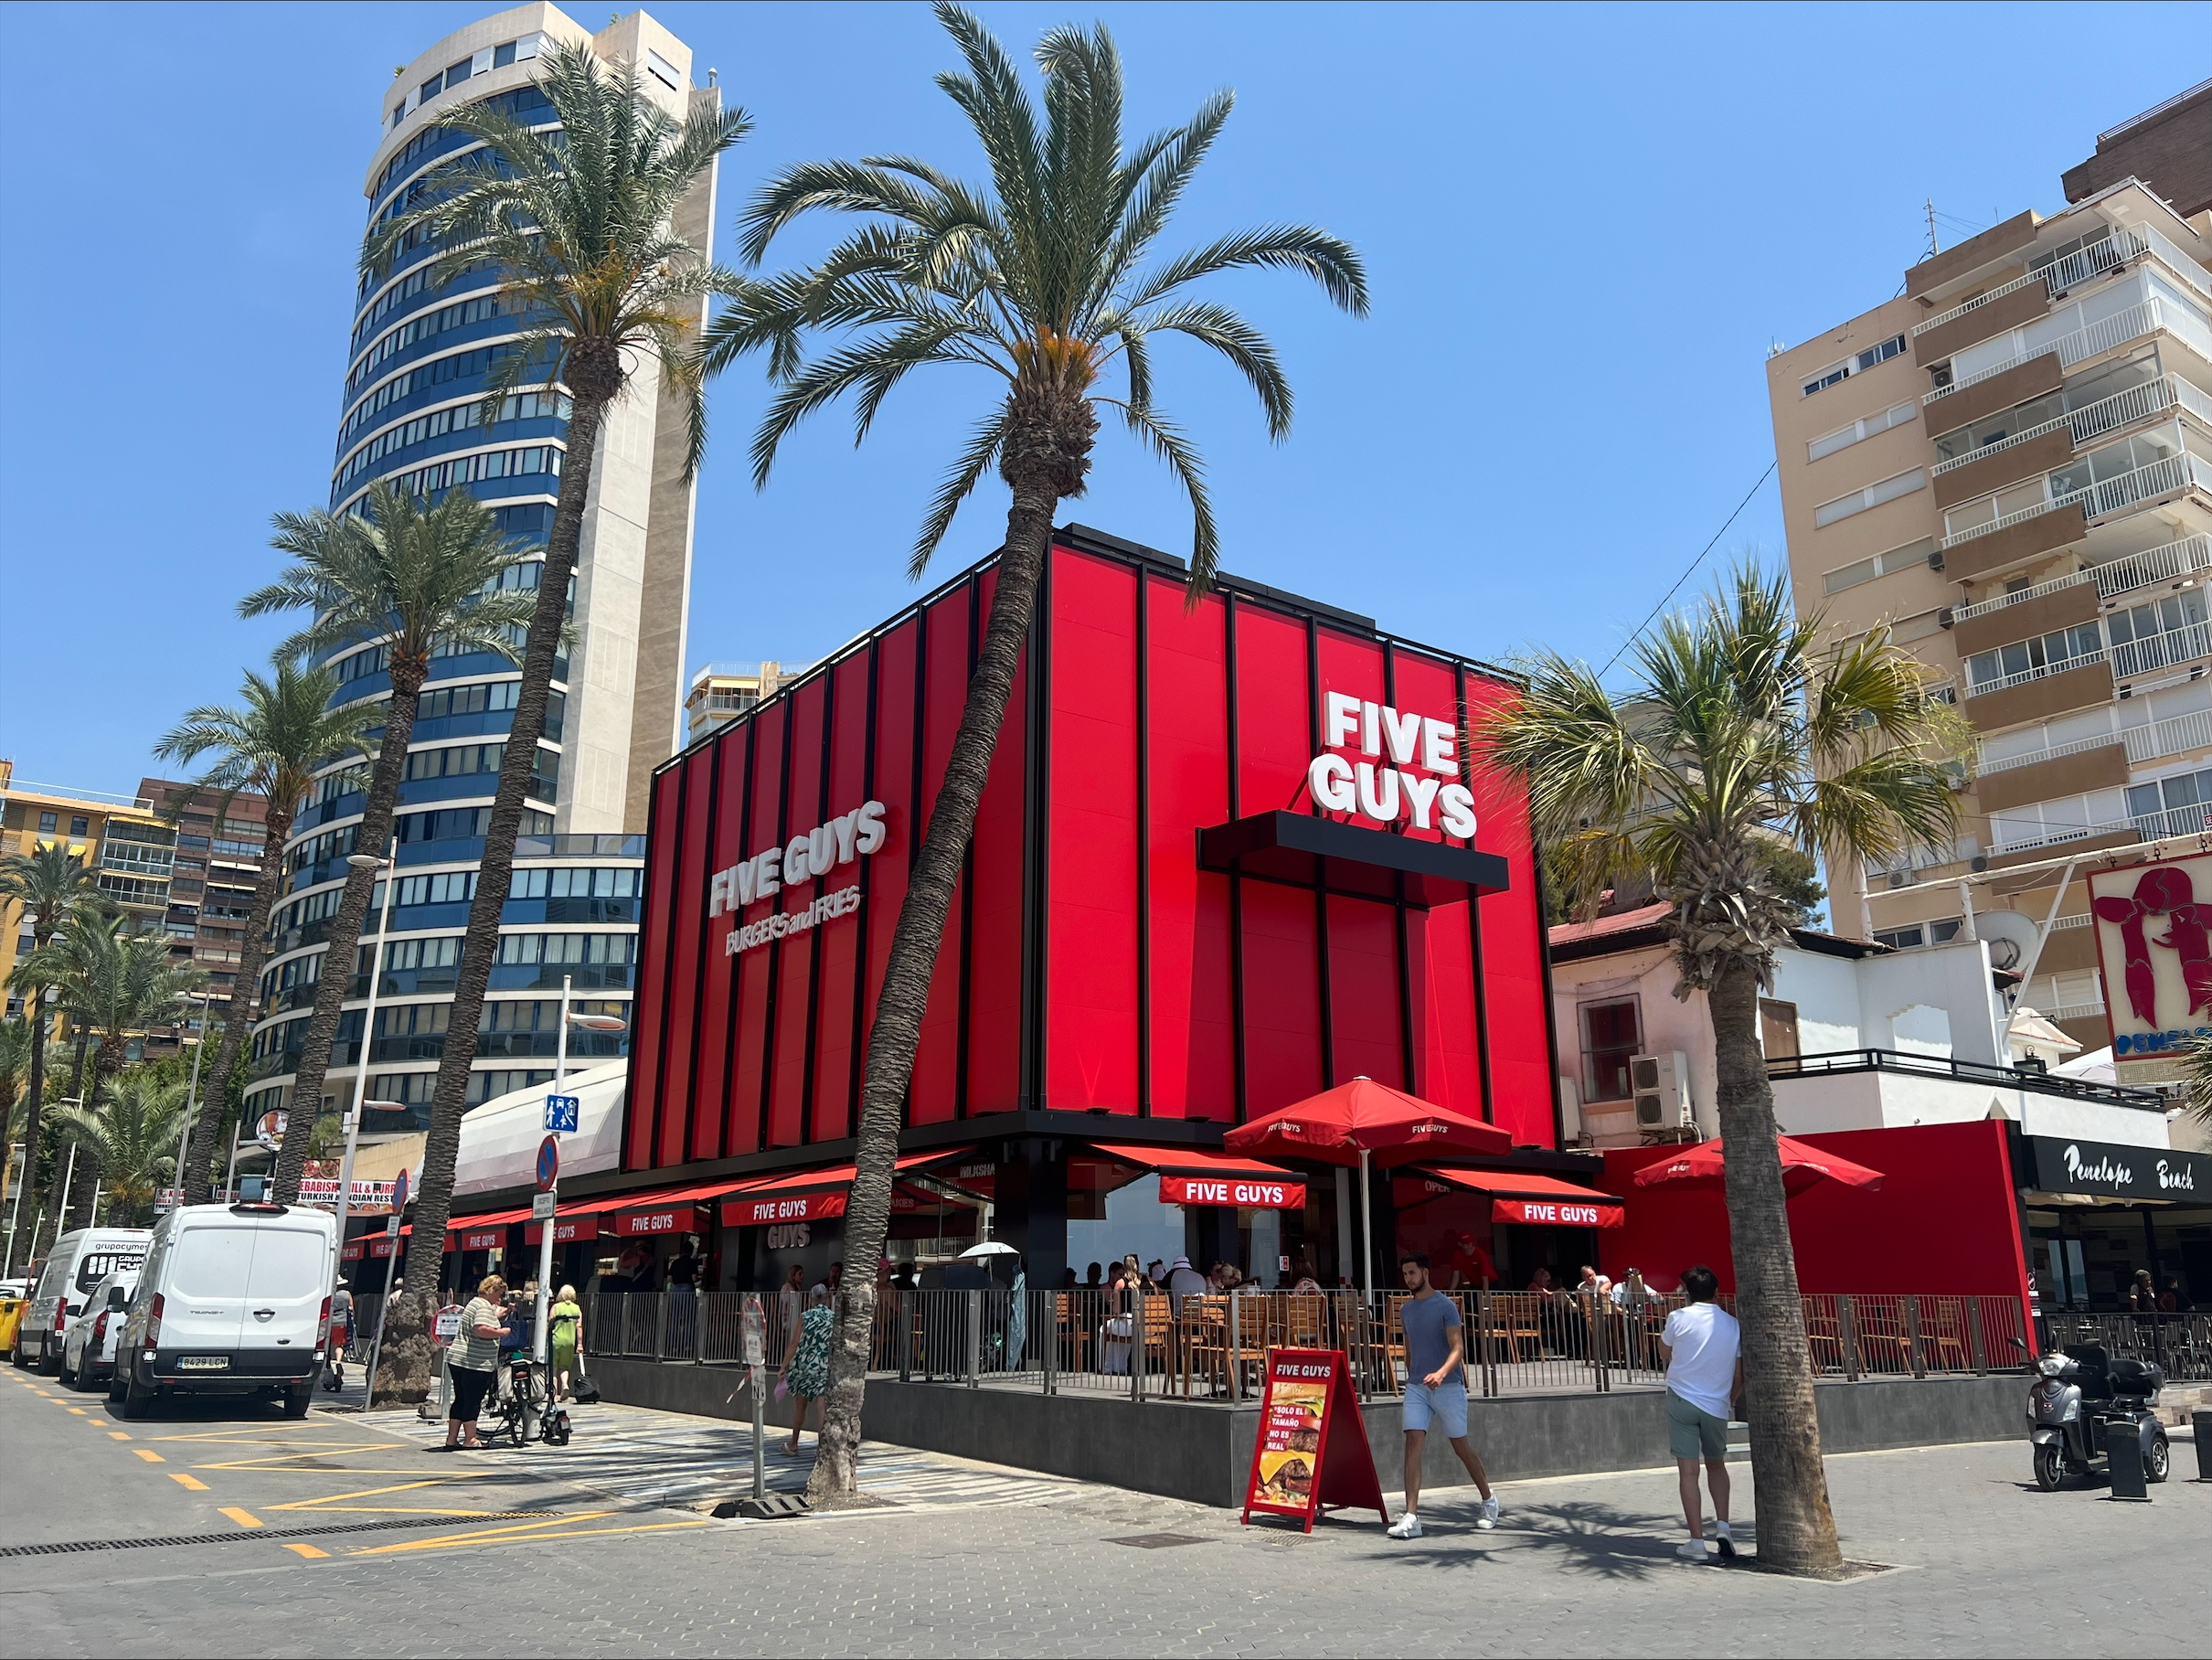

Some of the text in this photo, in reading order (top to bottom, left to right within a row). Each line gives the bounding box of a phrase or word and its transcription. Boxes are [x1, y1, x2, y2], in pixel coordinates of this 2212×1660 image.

[1324, 690, 1459, 777] FIVE
[1308, 753, 1478, 839] GUYS
[709, 800, 886, 919] FIVE GUYS
[725, 885, 861, 957] BURGERS and FRIES
[2064, 1144, 2195, 1191] Penelope Beach
[300, 1180, 338, 1193] EBABISH
[1186, 1183, 1283, 1204] FIVE GUYS
[753, 1199, 806, 1220] FIVE GUYS
[1525, 1205, 1598, 1223] FIVE GUYS
[632, 1214, 673, 1231] FIVE GUYS
[558, 1225, 575, 1239] GUYS
[768, 1223, 810, 1250] GUYS
[470, 1234, 496, 1248] FIVE GUYS
[184, 1357, 227, 1367] 8429 LCN
[1276, 1364, 1331, 1378] FIVE GUYS
[1271, 1418, 1300, 1427] TAMAÑO
[1269, 1430, 1290, 1439] NO ES
[1267, 1442, 1284, 1451] REAL
